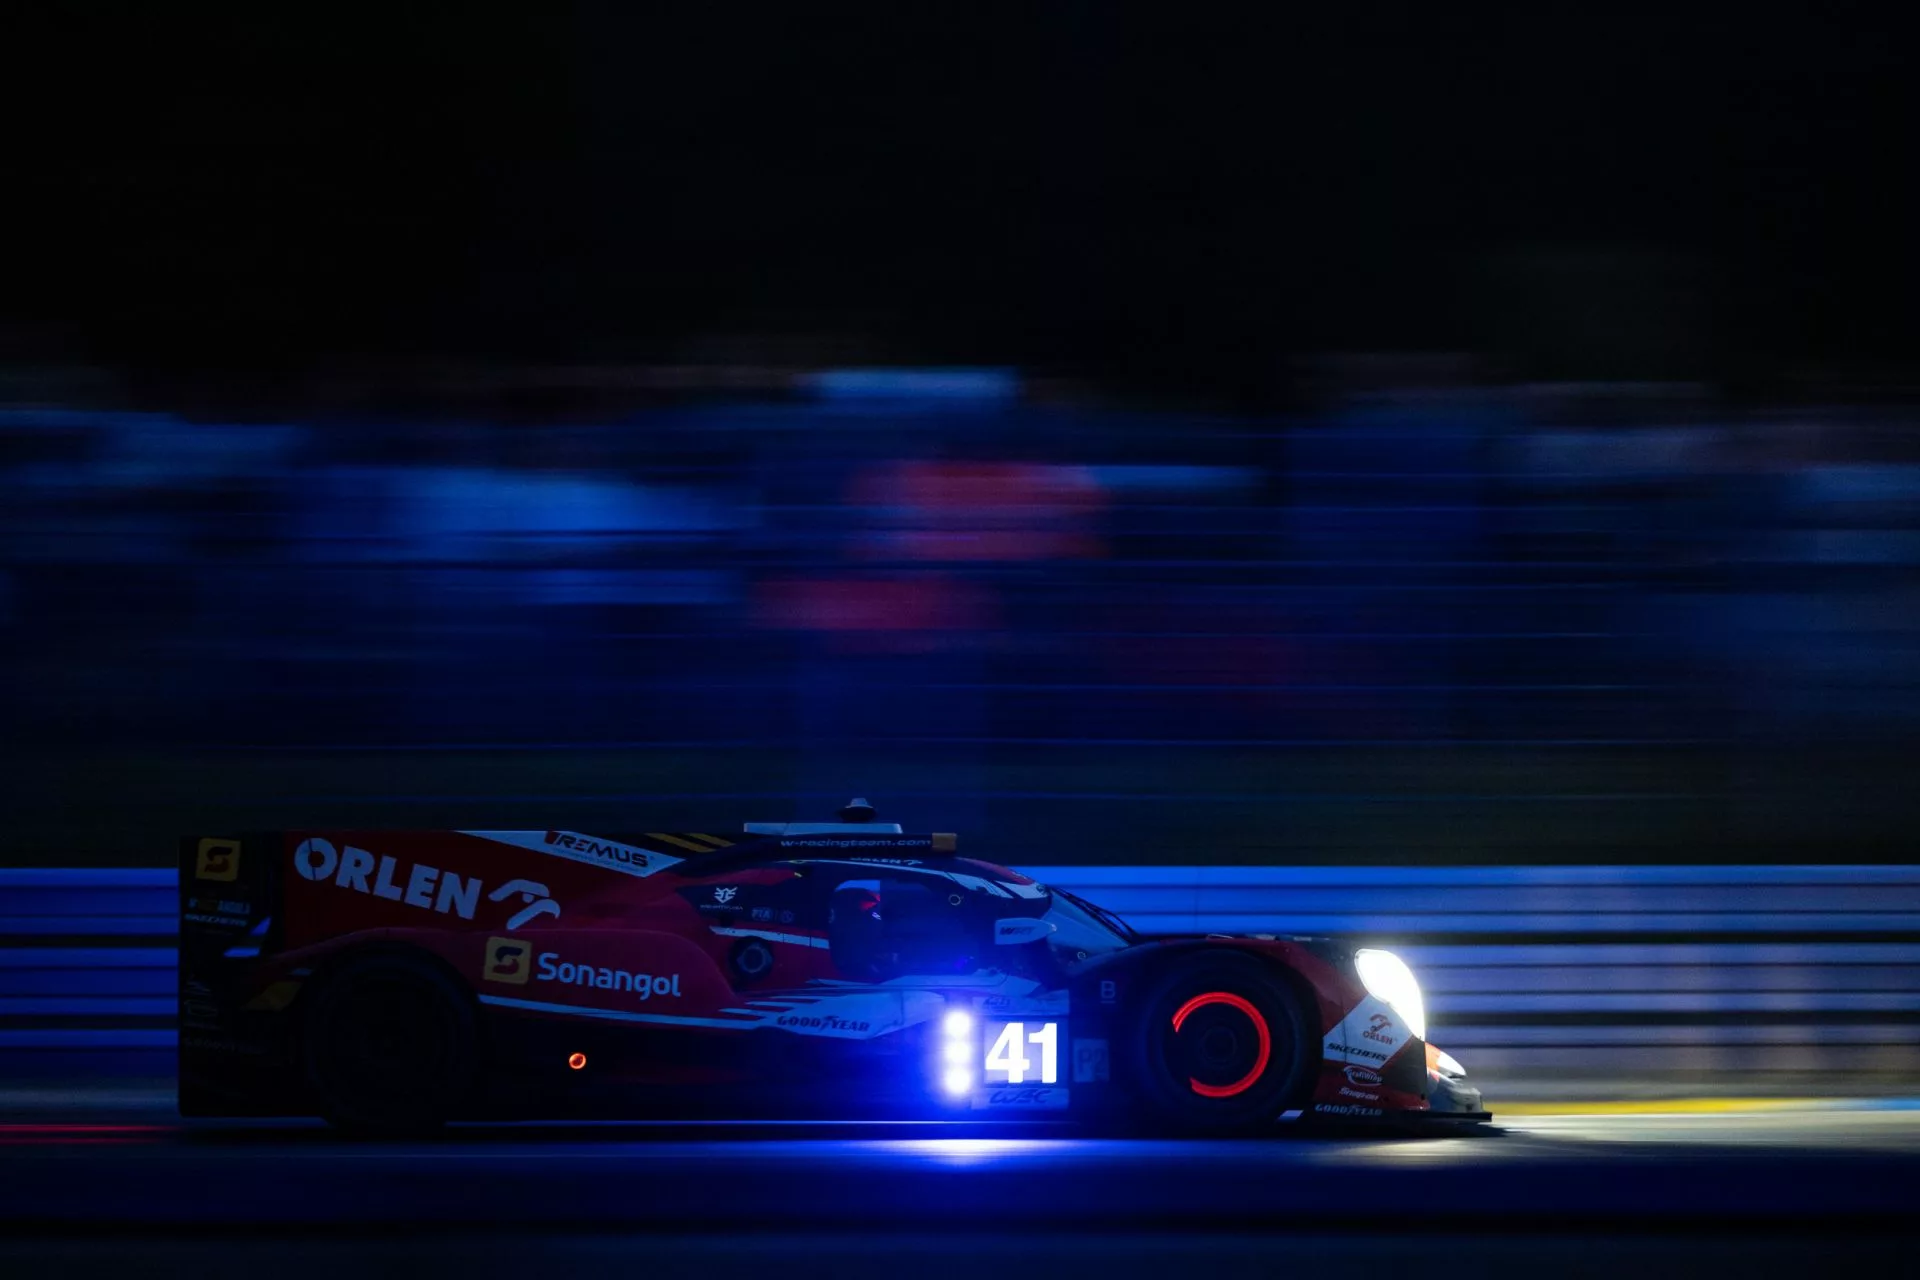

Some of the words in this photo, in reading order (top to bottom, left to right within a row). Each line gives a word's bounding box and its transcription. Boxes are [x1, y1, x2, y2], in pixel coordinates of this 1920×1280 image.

[555, 834, 648, 867] REMUS
[294, 837, 483, 920] ORLEN
[535, 952, 682, 1001] Sonangol
[984, 1022, 1058, 1084] 41
[1327, 1042, 1389, 1061] SKECHERS
[1362, 1030, 1393, 1045] ORLEN
